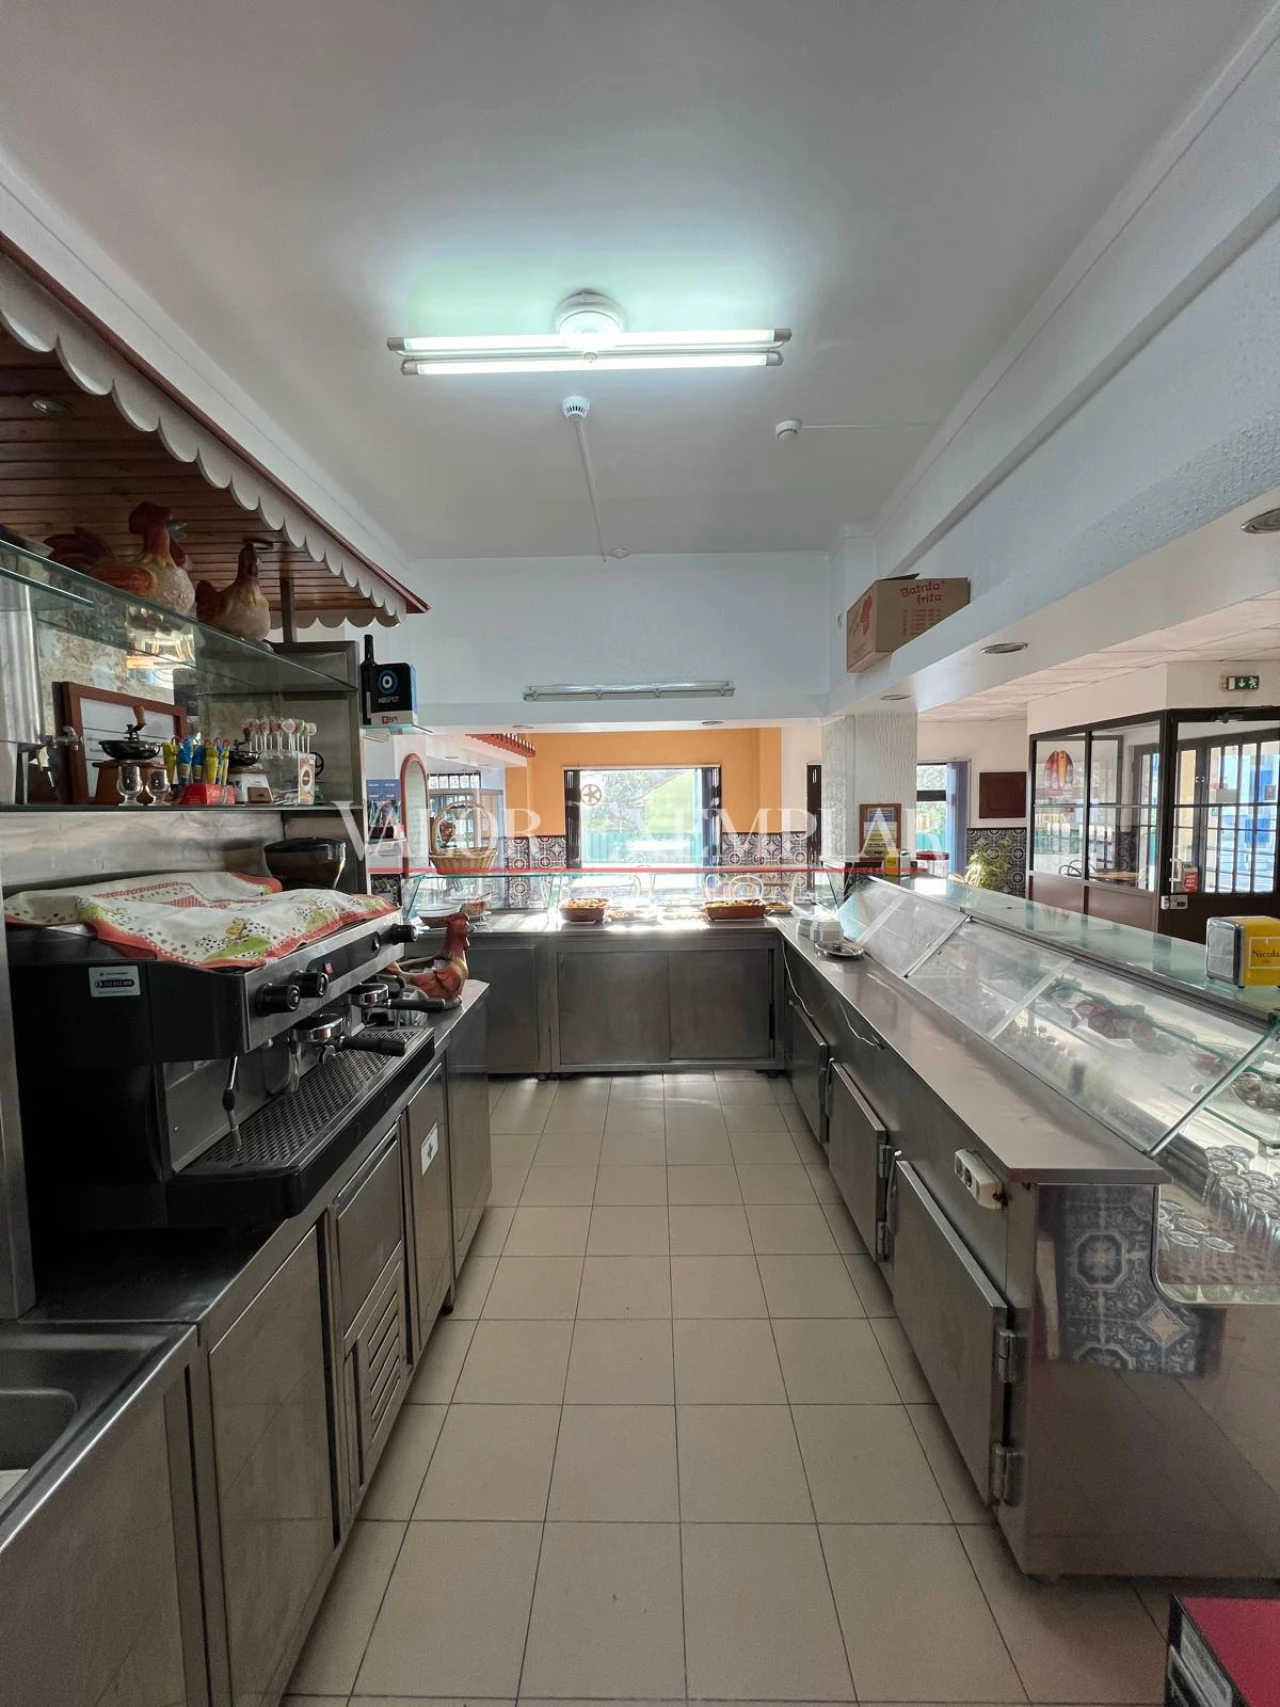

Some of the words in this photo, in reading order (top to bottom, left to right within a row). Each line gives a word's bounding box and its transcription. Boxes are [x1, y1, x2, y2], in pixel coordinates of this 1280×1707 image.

[899, 580, 941, 598] Batata
[917, 593, 942, 605] frita
[1251, 949, 1280, 958] Nicola
